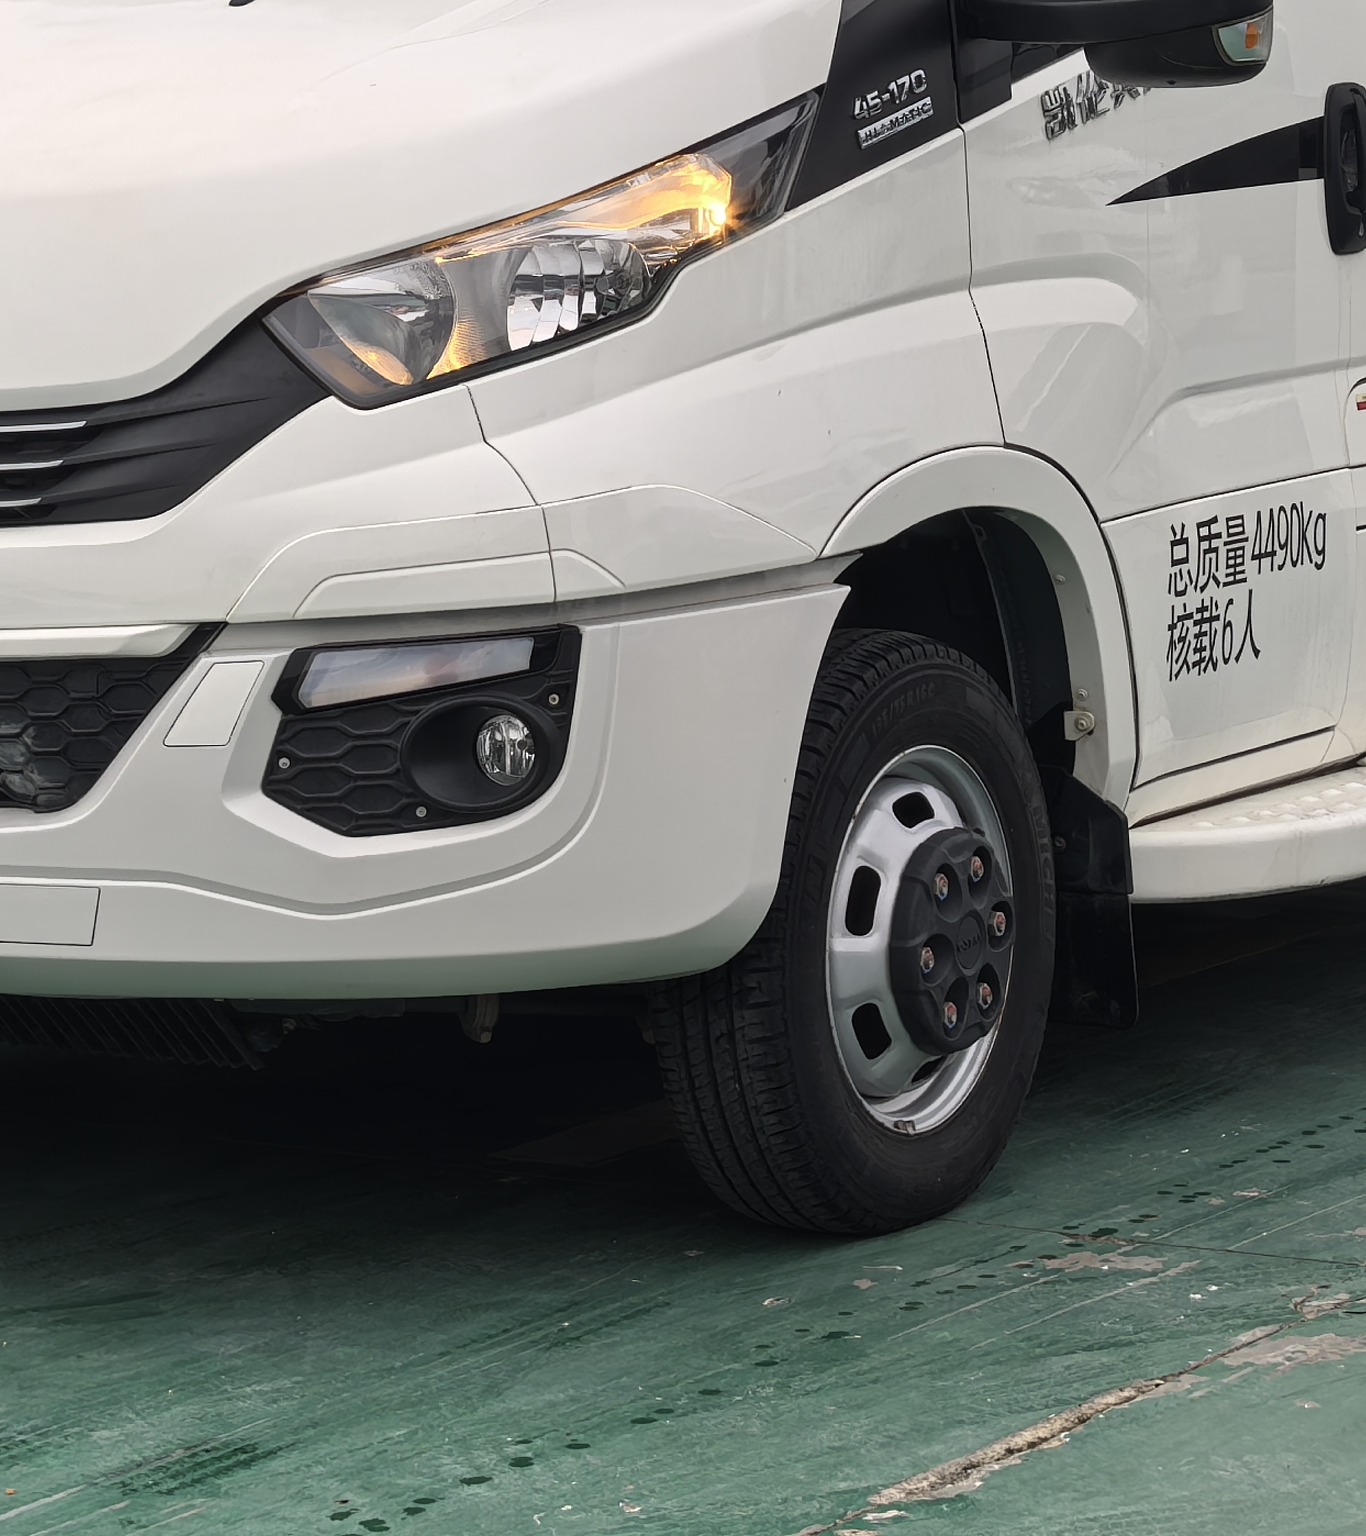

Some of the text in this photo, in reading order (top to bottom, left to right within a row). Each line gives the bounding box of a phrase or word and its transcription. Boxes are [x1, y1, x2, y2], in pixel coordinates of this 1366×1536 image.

[854, 69, 928, 120] 45-170
[1167, 500, 1327, 598] 总质量4490kg
[1166, 588, 1261, 682] 核载6人
